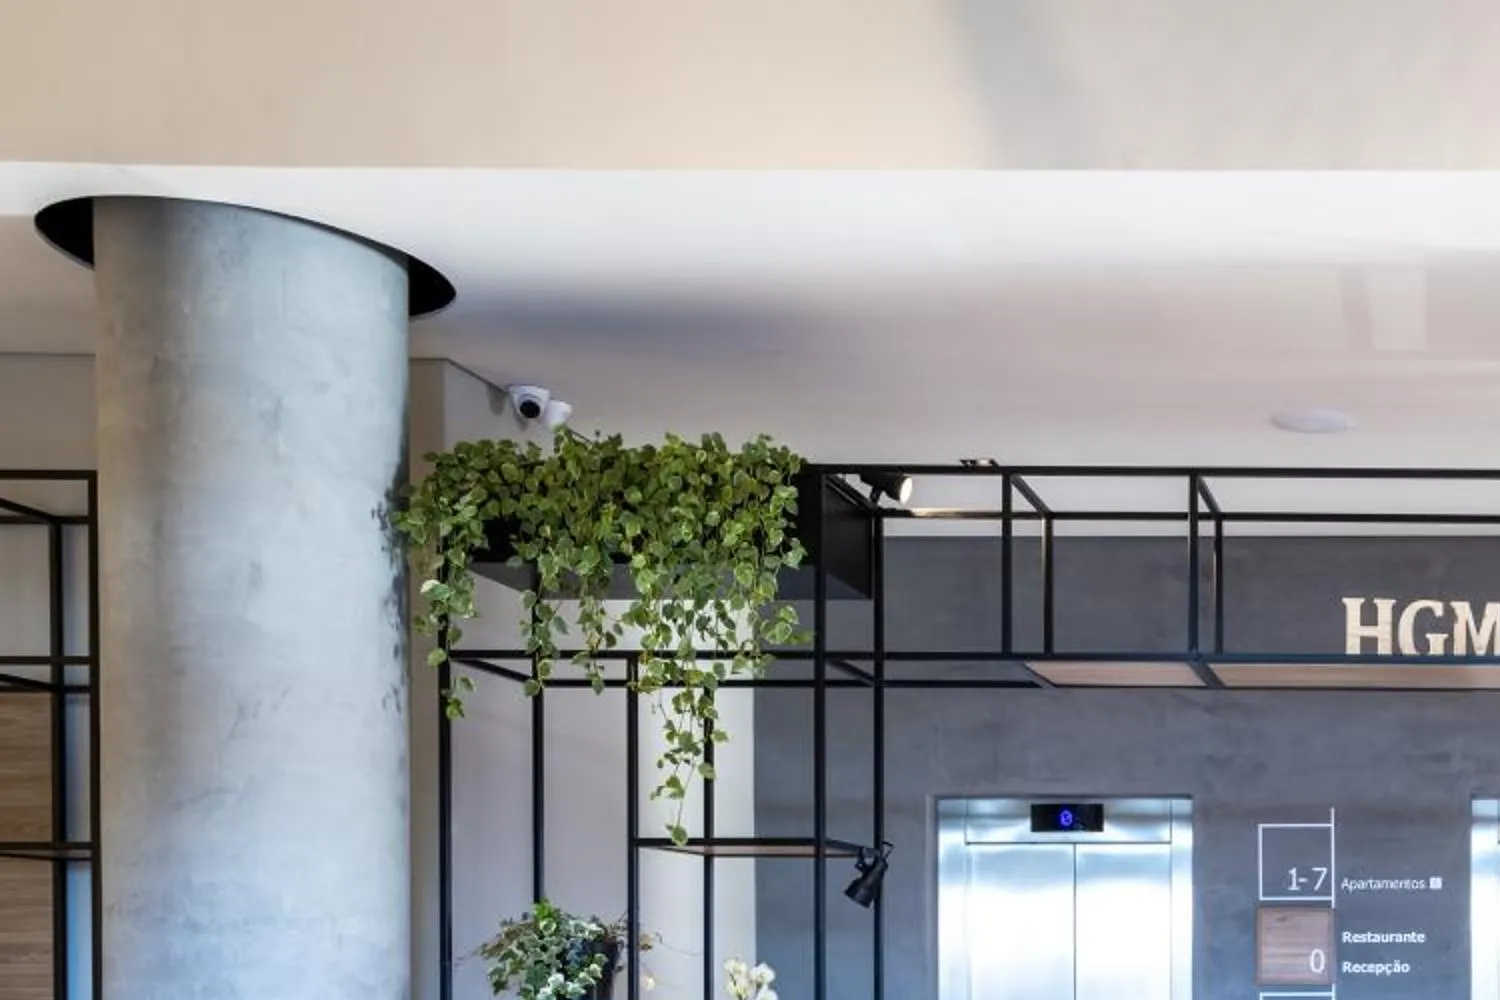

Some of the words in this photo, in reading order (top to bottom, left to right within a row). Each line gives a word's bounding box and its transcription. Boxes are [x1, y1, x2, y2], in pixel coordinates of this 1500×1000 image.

[1287, 867, 1328, 891] 1-7
[1341, 878, 1426, 893] Apartamentos
[1342, 931, 1426, 943] Restaurante
[1309, 949, 1326, 974] 0
[1342, 959, 1411, 976] Recepção
